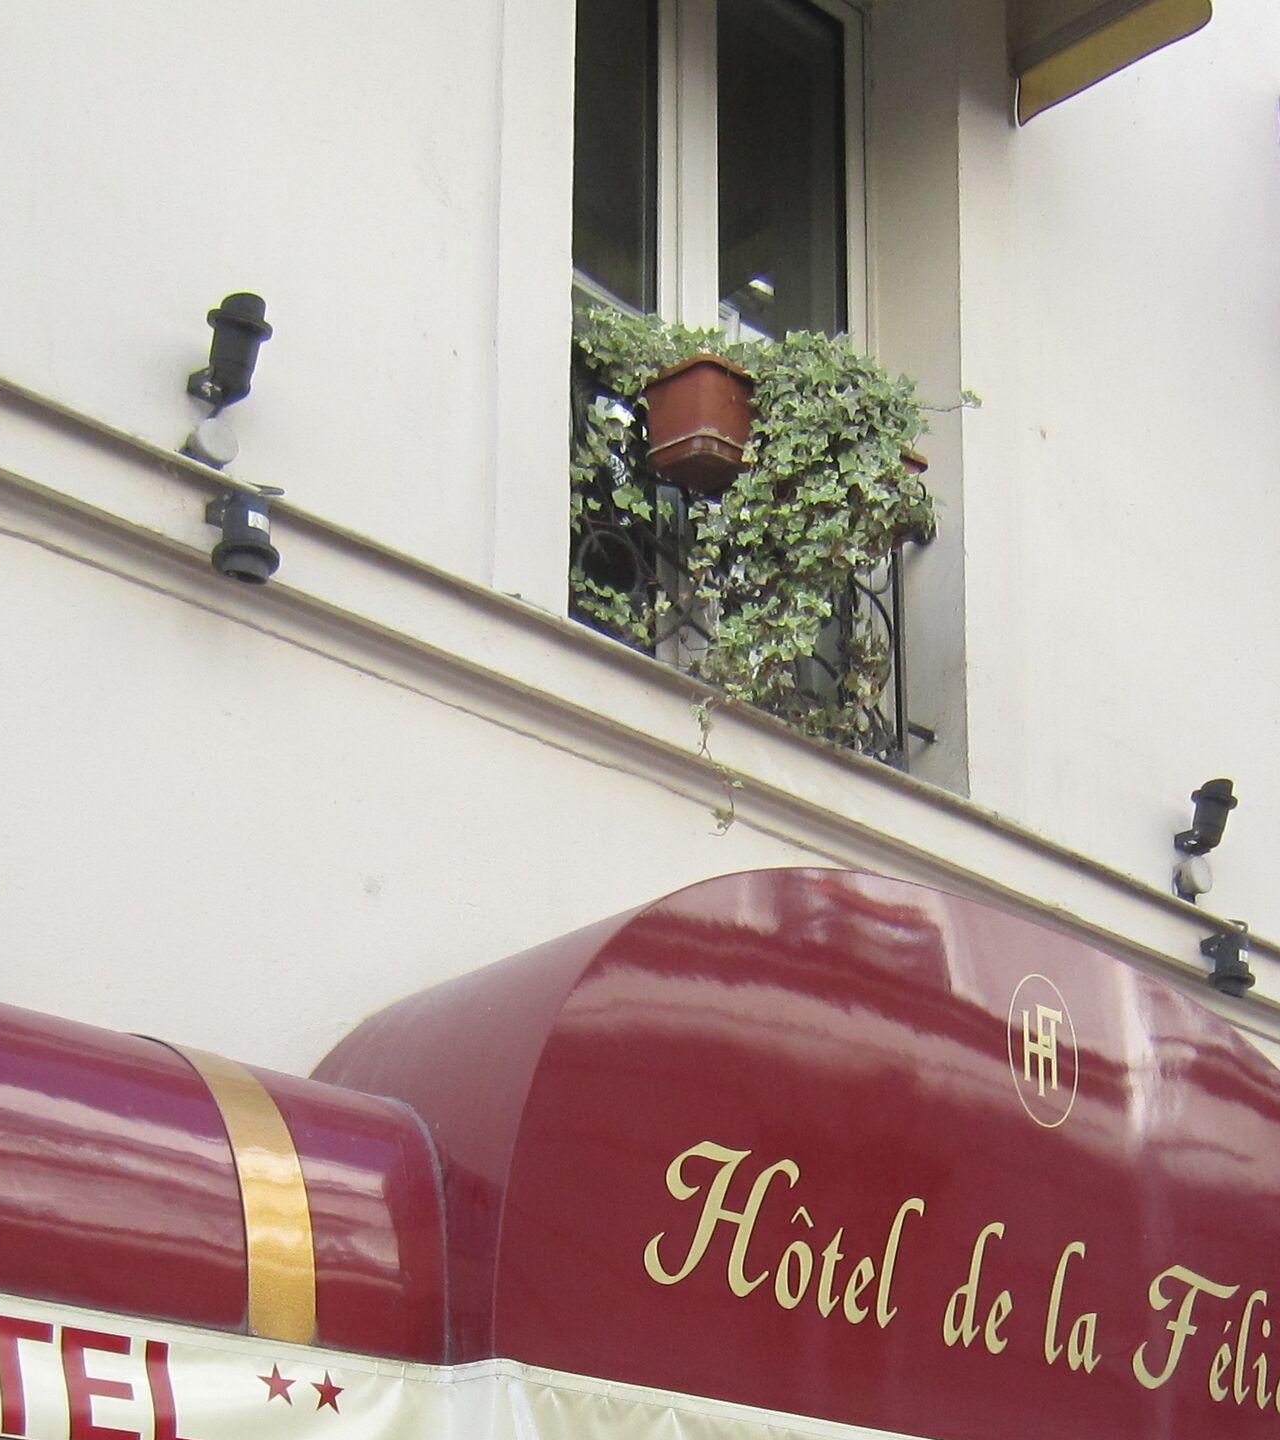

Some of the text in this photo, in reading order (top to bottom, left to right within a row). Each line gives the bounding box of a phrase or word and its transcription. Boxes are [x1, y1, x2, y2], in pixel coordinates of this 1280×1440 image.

[642, 1139, 926, 1330] Hôtel
[941, 1221, 1014, 1356] de
[1043, 1240, 1102, 1374] la
